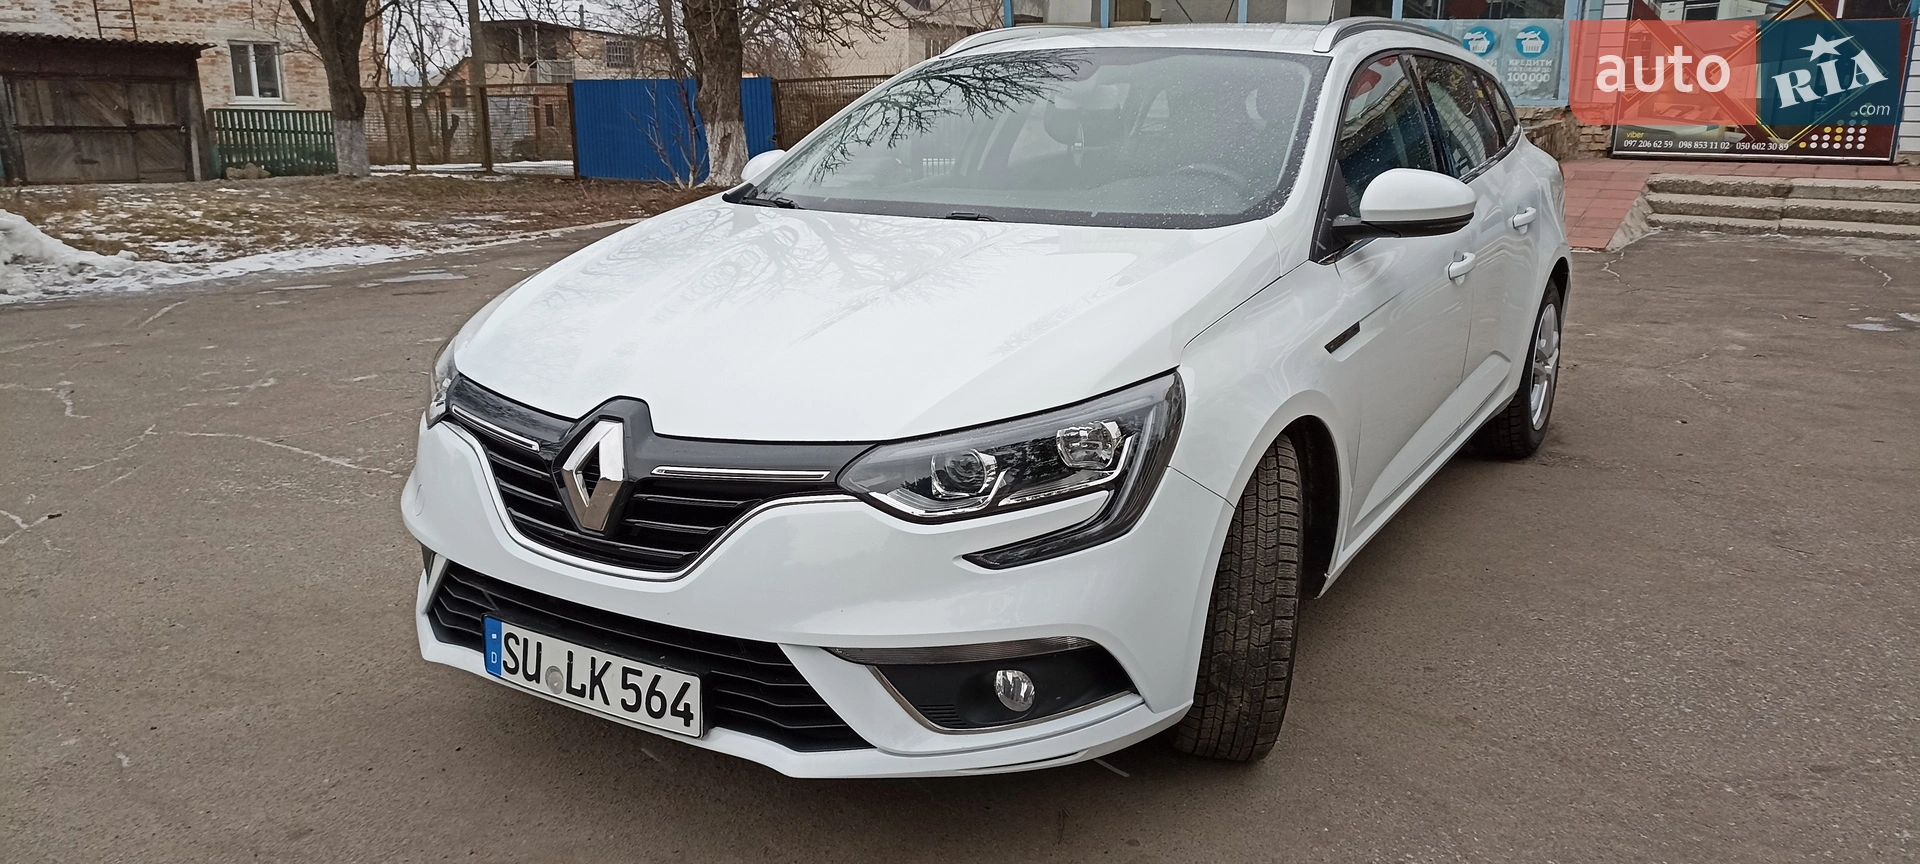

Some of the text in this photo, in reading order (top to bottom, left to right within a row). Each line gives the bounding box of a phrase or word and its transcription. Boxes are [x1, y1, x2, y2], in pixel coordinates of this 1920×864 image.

[1507, 73, 1550, 82] 100 000
[1638, 140, 1651, 148] 206
[1653, 140, 1662, 148] 62
[1678, 141, 1692, 149] 098
[1693, 141, 1708, 149] 853
[1778, 143, 1789, 151] 89
[491, 652, 497, 663] D
[502, 632, 694, 728] SU LK 564
